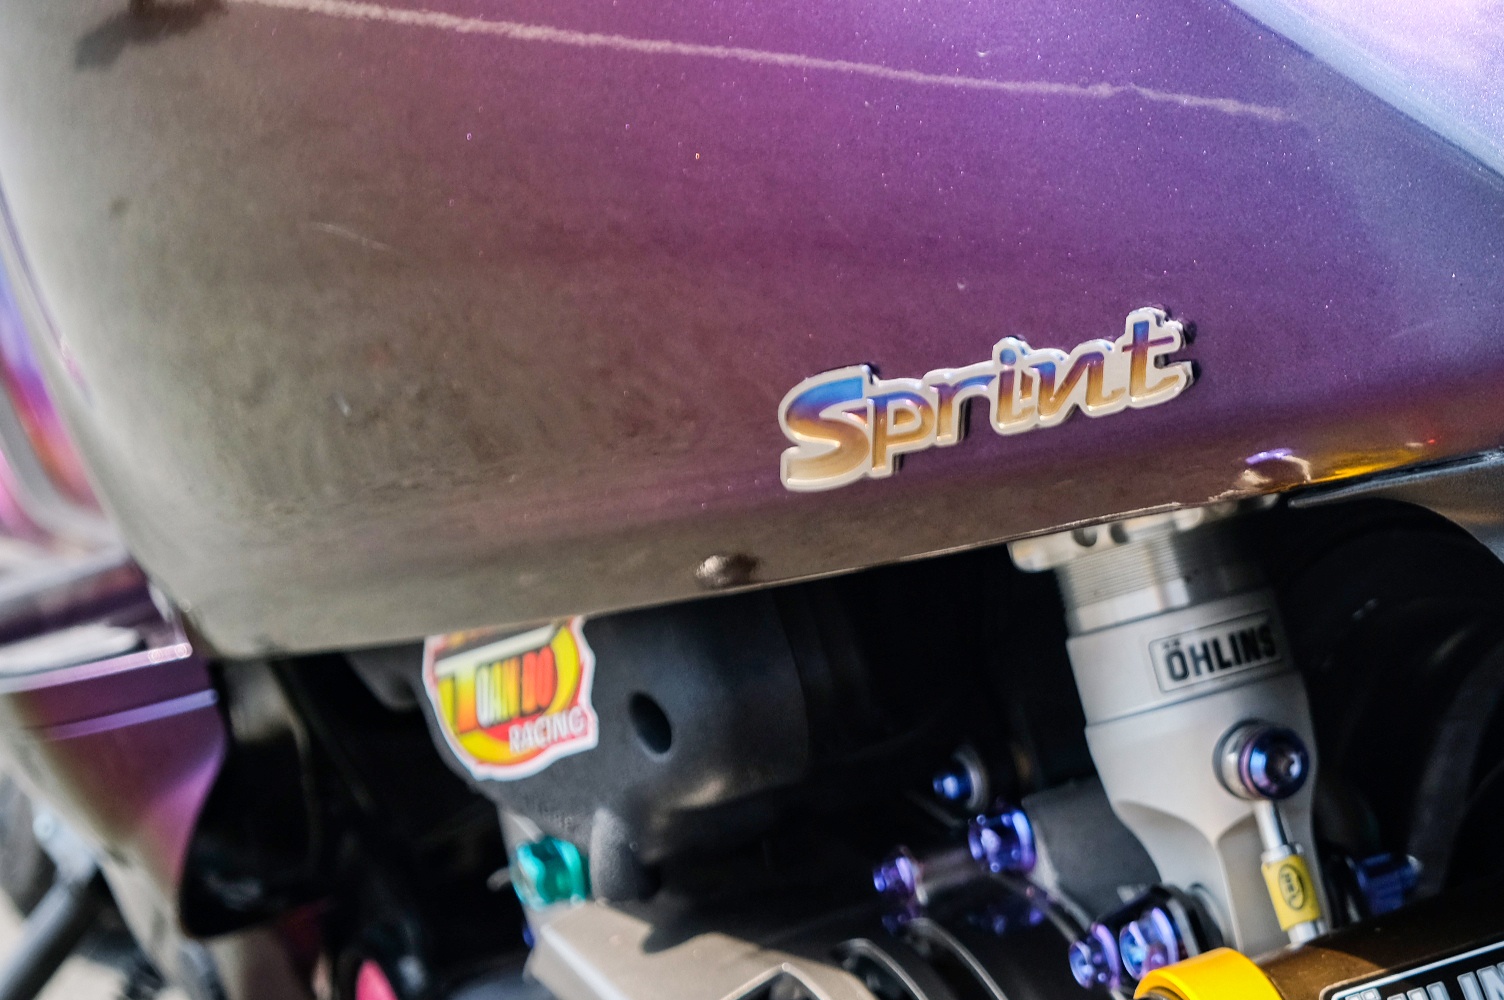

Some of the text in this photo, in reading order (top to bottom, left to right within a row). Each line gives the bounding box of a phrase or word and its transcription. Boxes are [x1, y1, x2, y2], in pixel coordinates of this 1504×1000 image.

[778, 307, 1192, 491] Sprint
[1162, 624, 1277, 682] ÖHLINS
[509, 706, 585, 752] RACING
